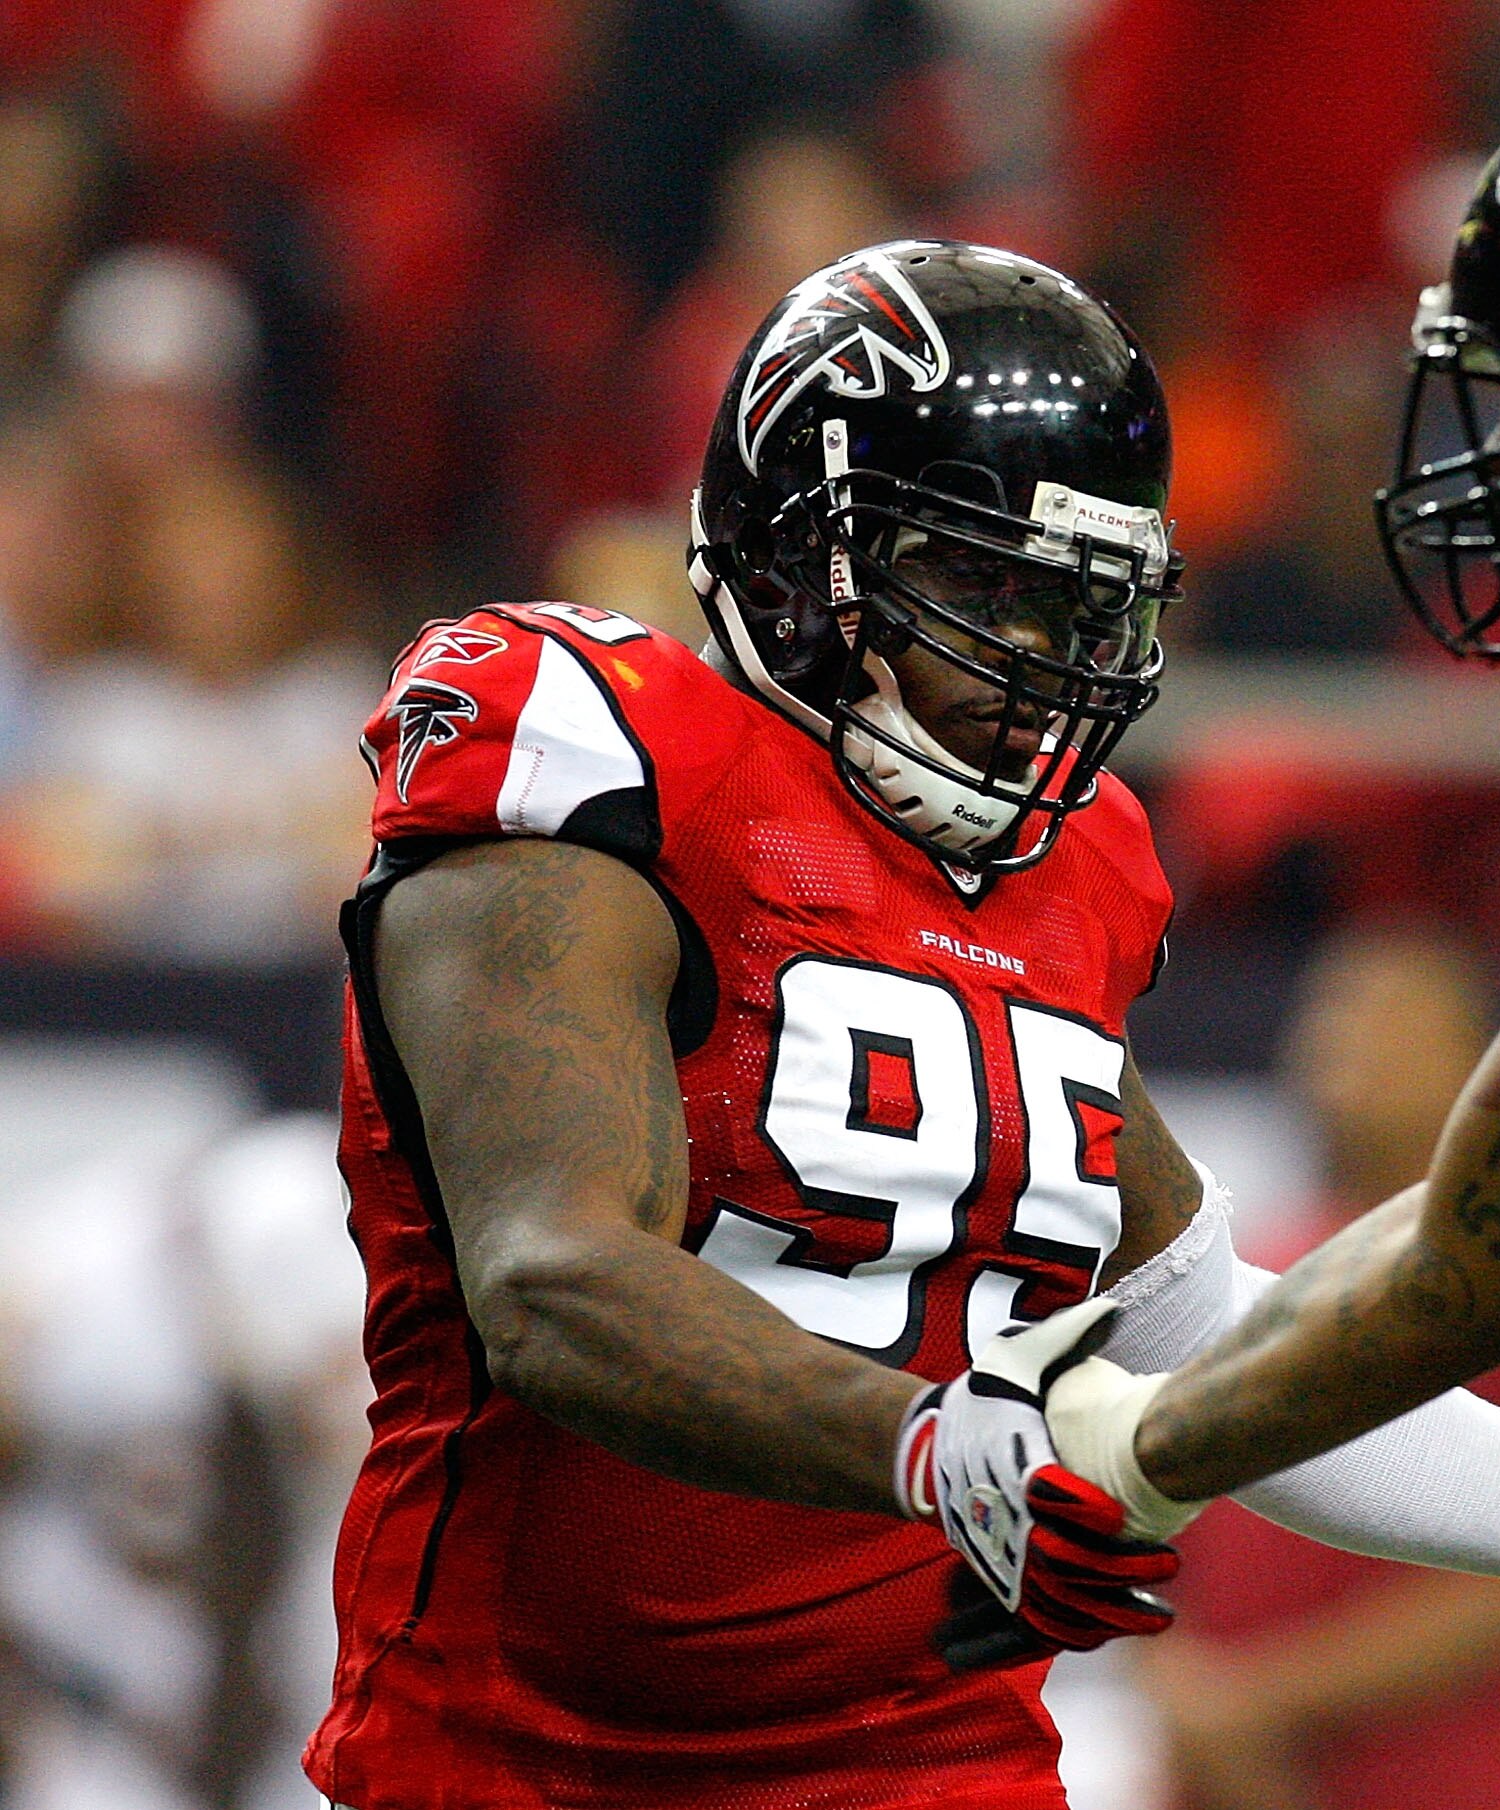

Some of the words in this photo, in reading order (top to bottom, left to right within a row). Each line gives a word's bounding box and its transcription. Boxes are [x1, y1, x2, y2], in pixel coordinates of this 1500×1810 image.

[1077, 507, 1132, 530] ALCONS
[952, 804, 994, 829] Riddell
[920, 929, 1025, 975] FALCONS
[692, 955, 1126, 1368] 95
